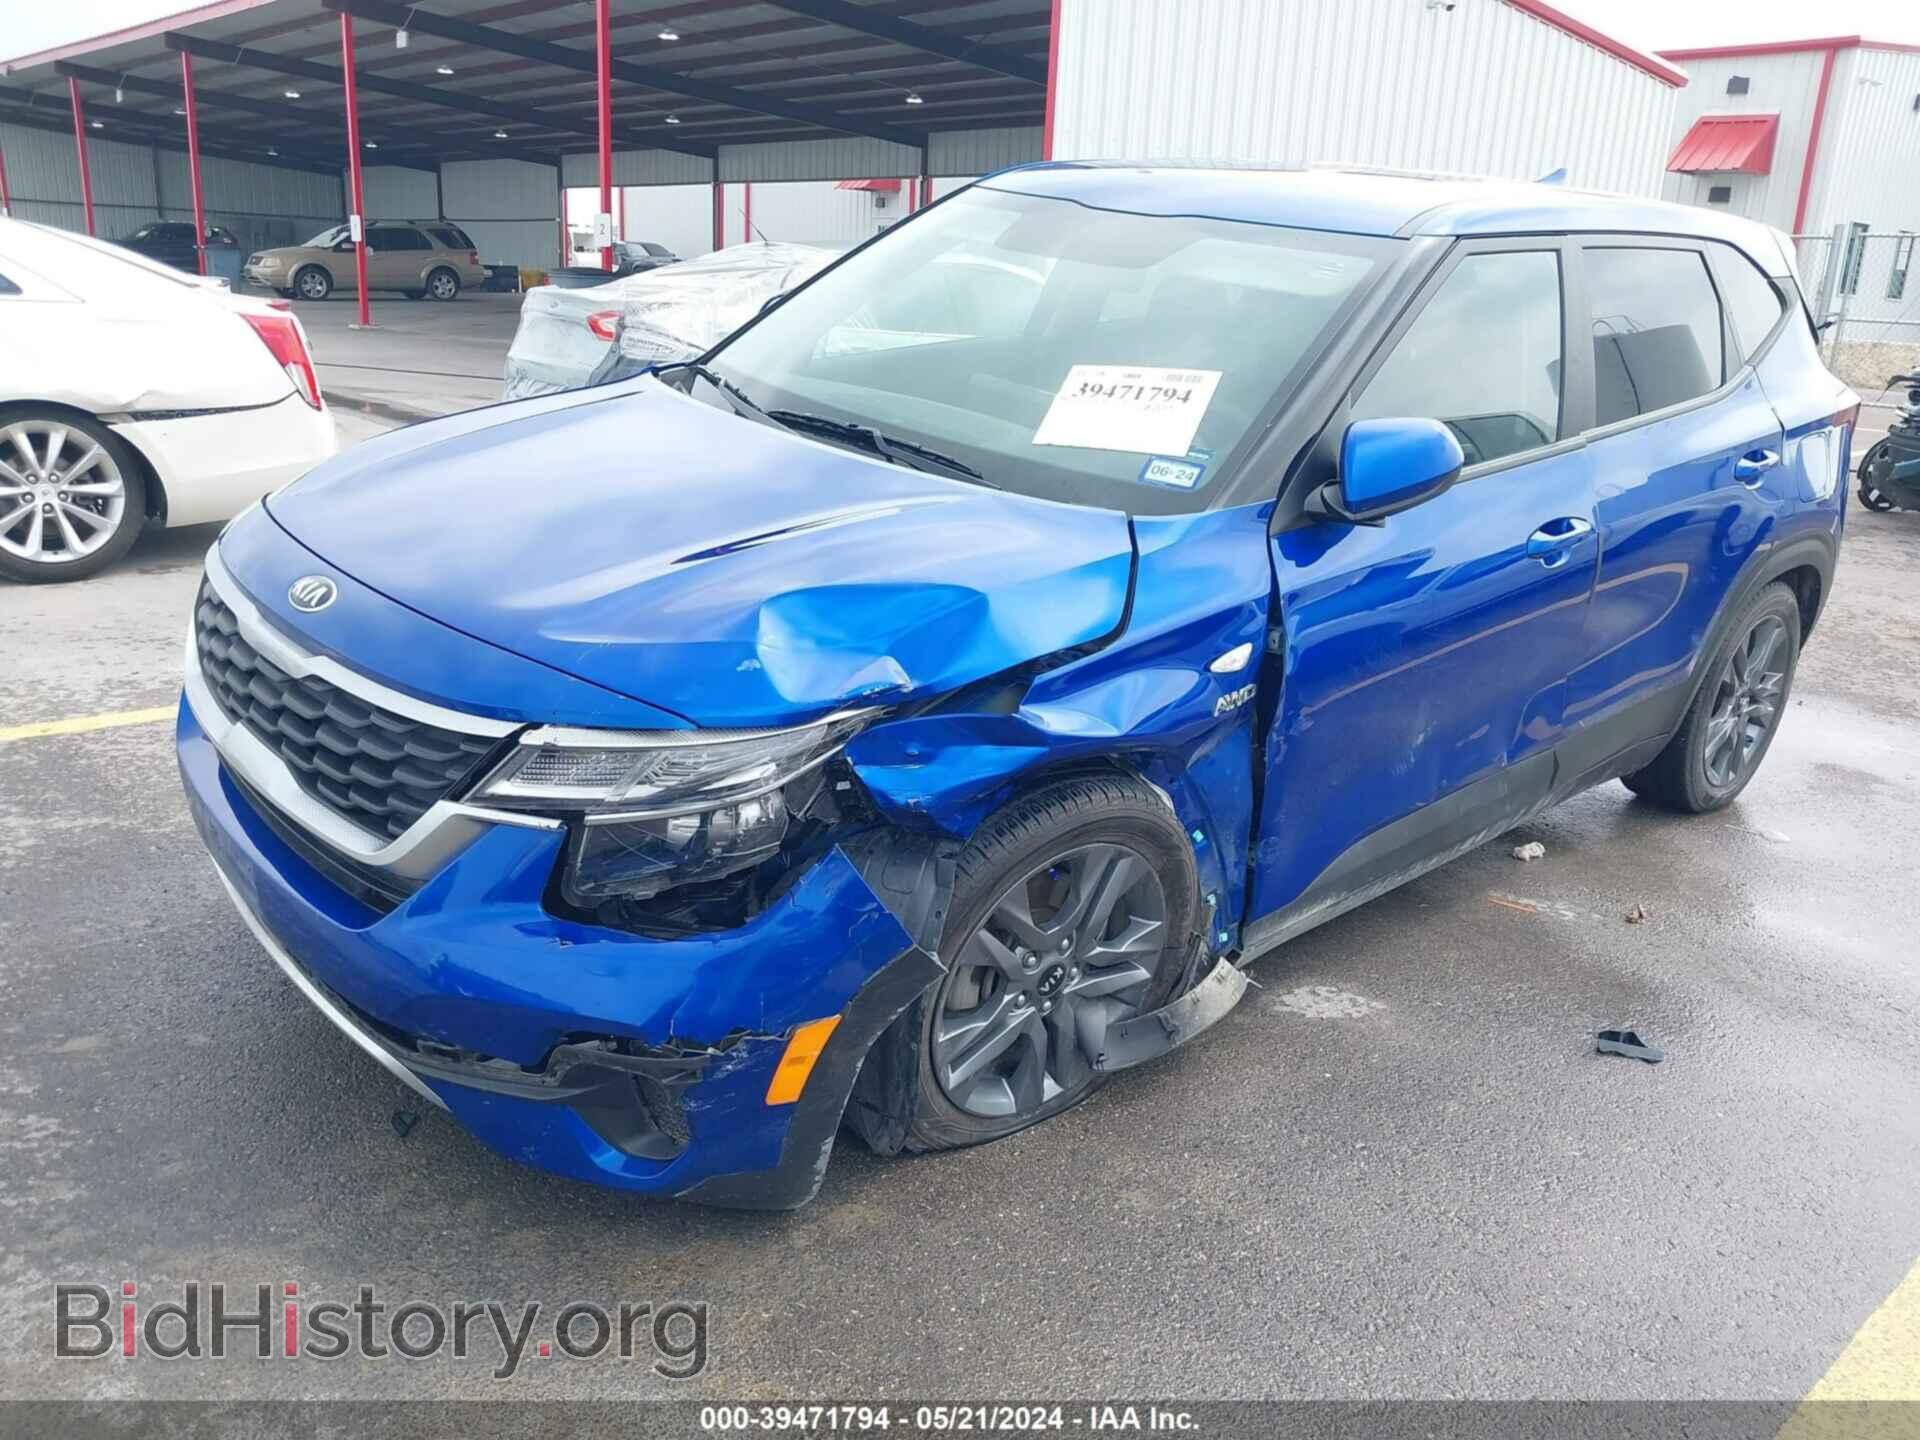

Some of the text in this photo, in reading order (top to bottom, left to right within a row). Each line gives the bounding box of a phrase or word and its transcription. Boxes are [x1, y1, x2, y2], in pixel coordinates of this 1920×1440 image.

[599, 223, 606, 235] 2
[1072, 382, 1193, 404] 39471794
[1213, 683, 1257, 718] AWD
[1039, 966, 1065, 992] KIA
